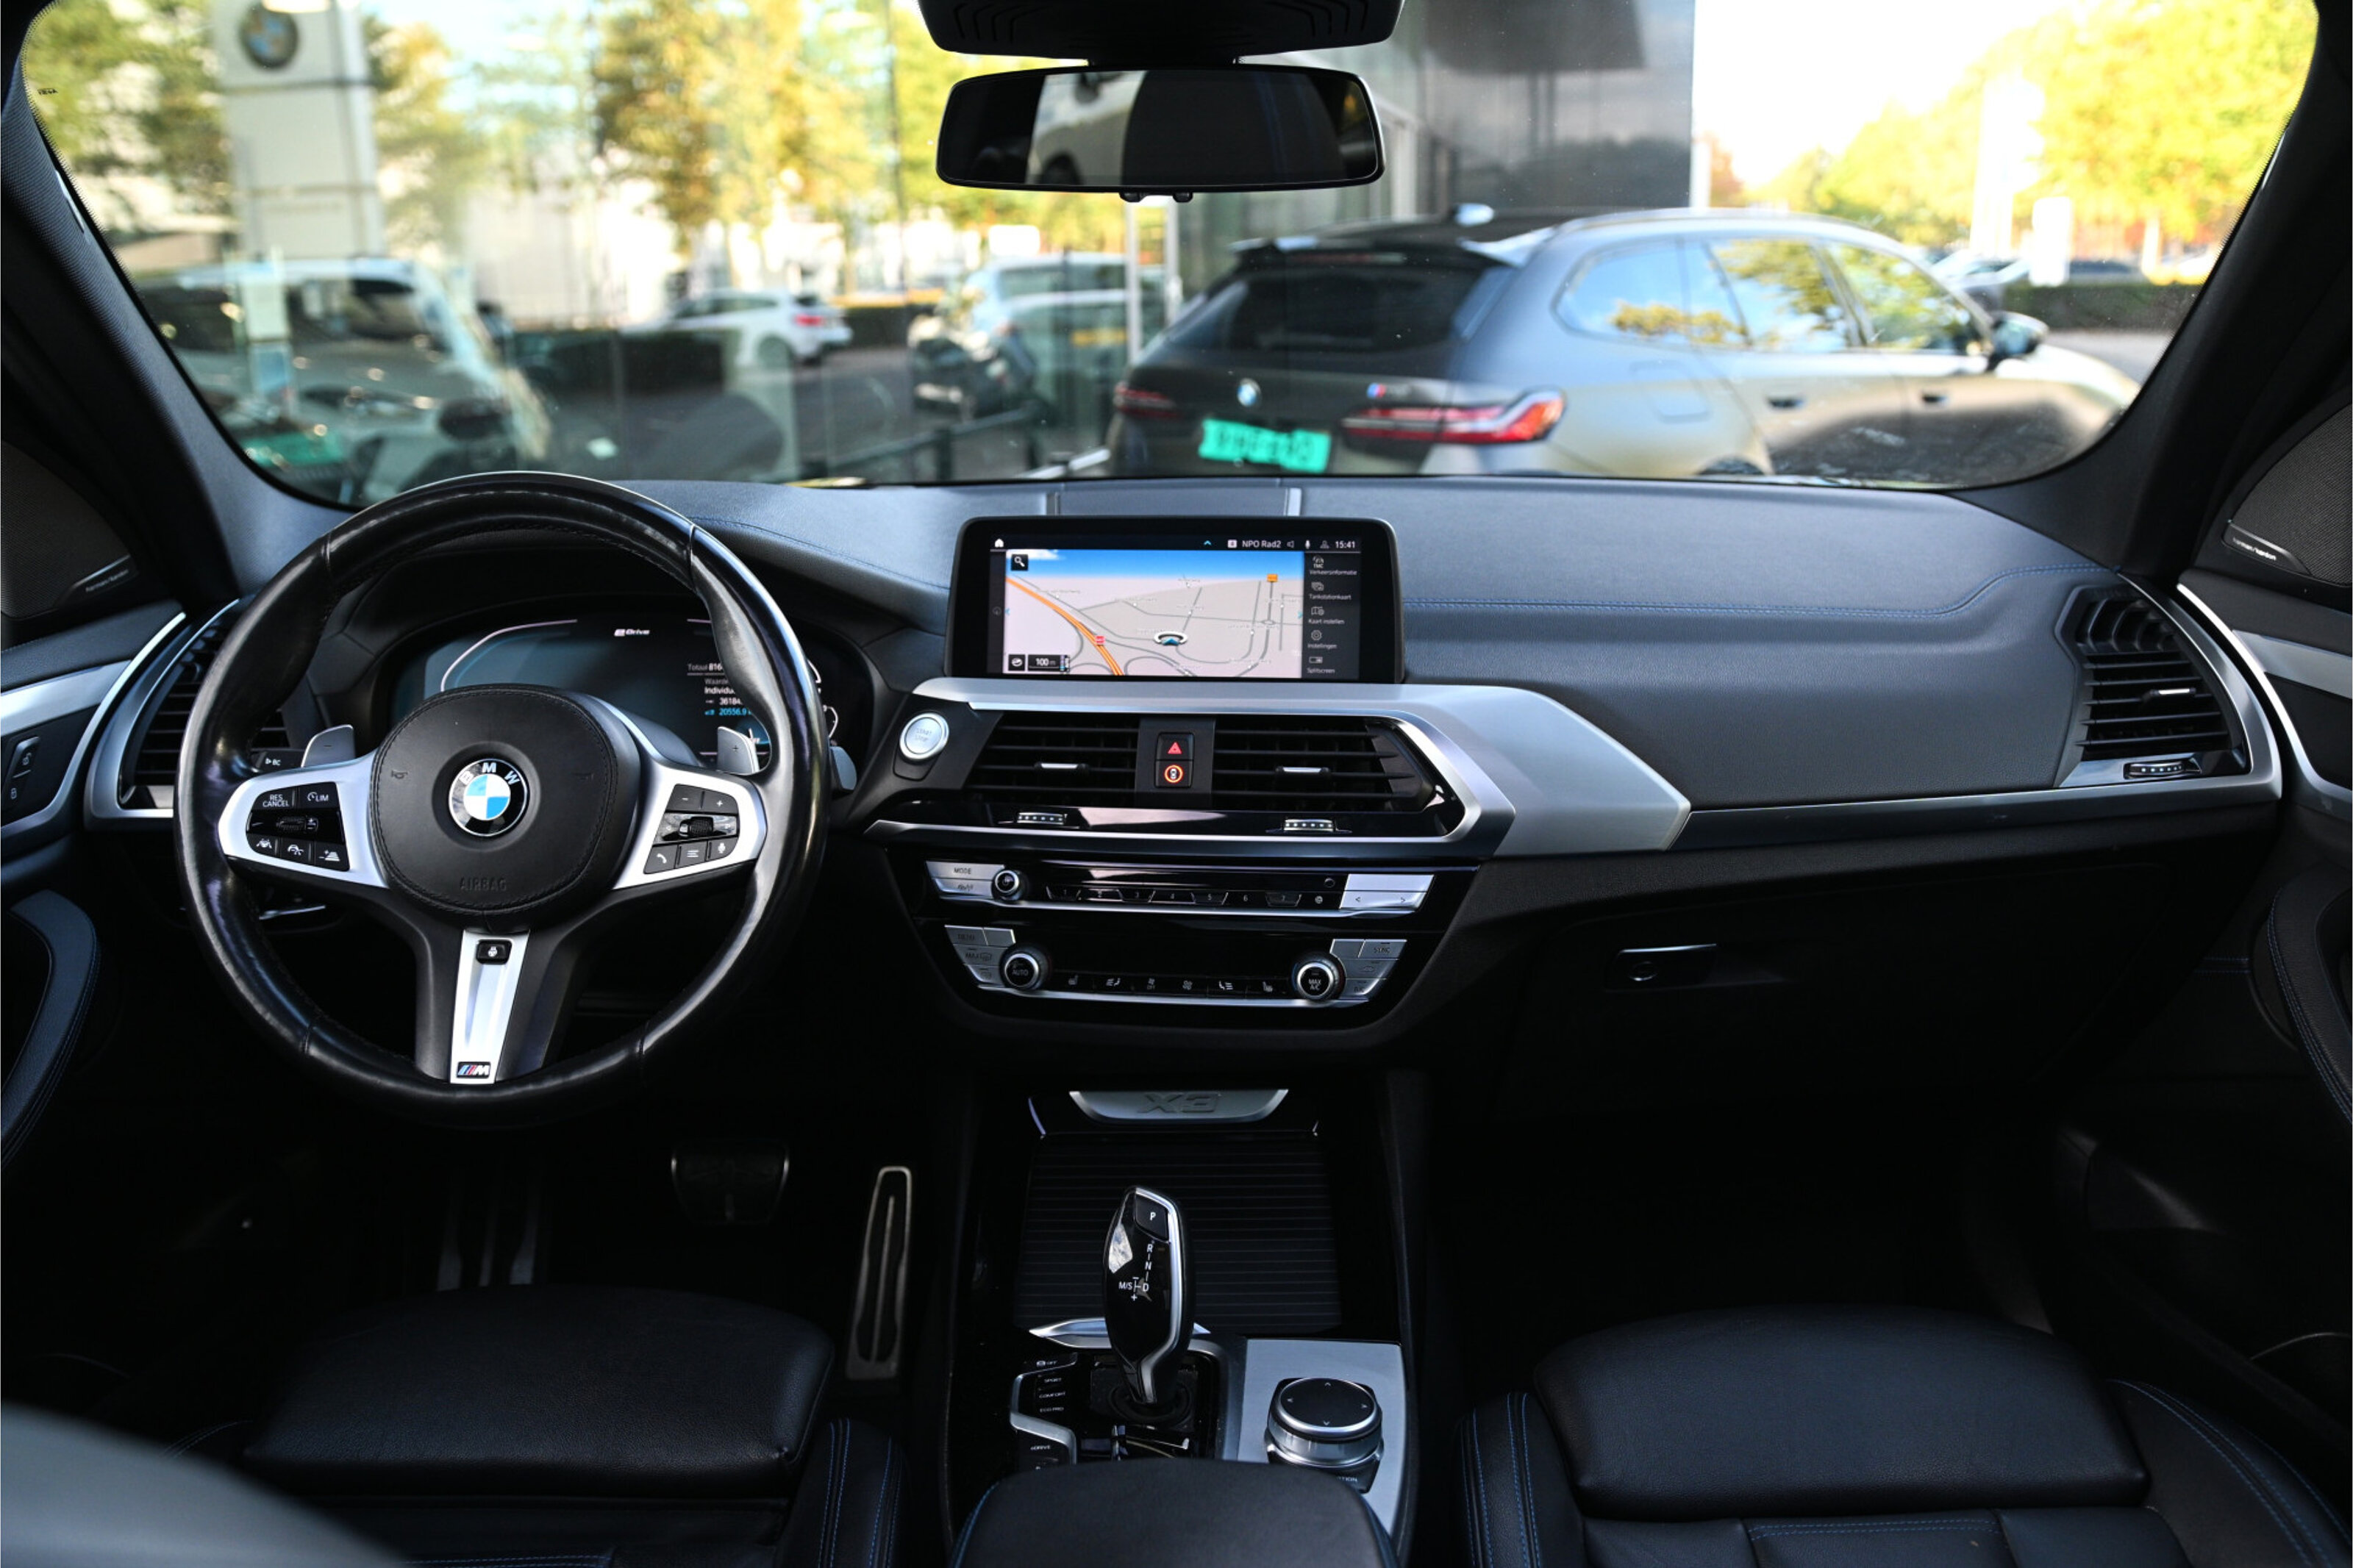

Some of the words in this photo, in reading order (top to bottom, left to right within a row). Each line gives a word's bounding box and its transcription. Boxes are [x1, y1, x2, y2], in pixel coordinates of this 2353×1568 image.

[1242, 540, 1260, 548] NPO
[1261, 540, 1282, 548] Rad2
[1335, 540, 1356, 549] 15:41
[708, 662, 724, 671] 816
[1035, 658, 1049, 666] 100
[459, 762, 521, 785] BMW
[315, 795, 329, 803] LIM
[460, 876, 507, 892] AIRBAG
[1136, 1093, 1221, 1114] X3
[1149, 1211, 1157, 1221] P
[1146, 1244, 1154, 1253] R
[1144, 1261, 1152, 1271] N
[1118, 1281, 1133, 1290] M/S
[1143, 1283, 1150, 1292] D
